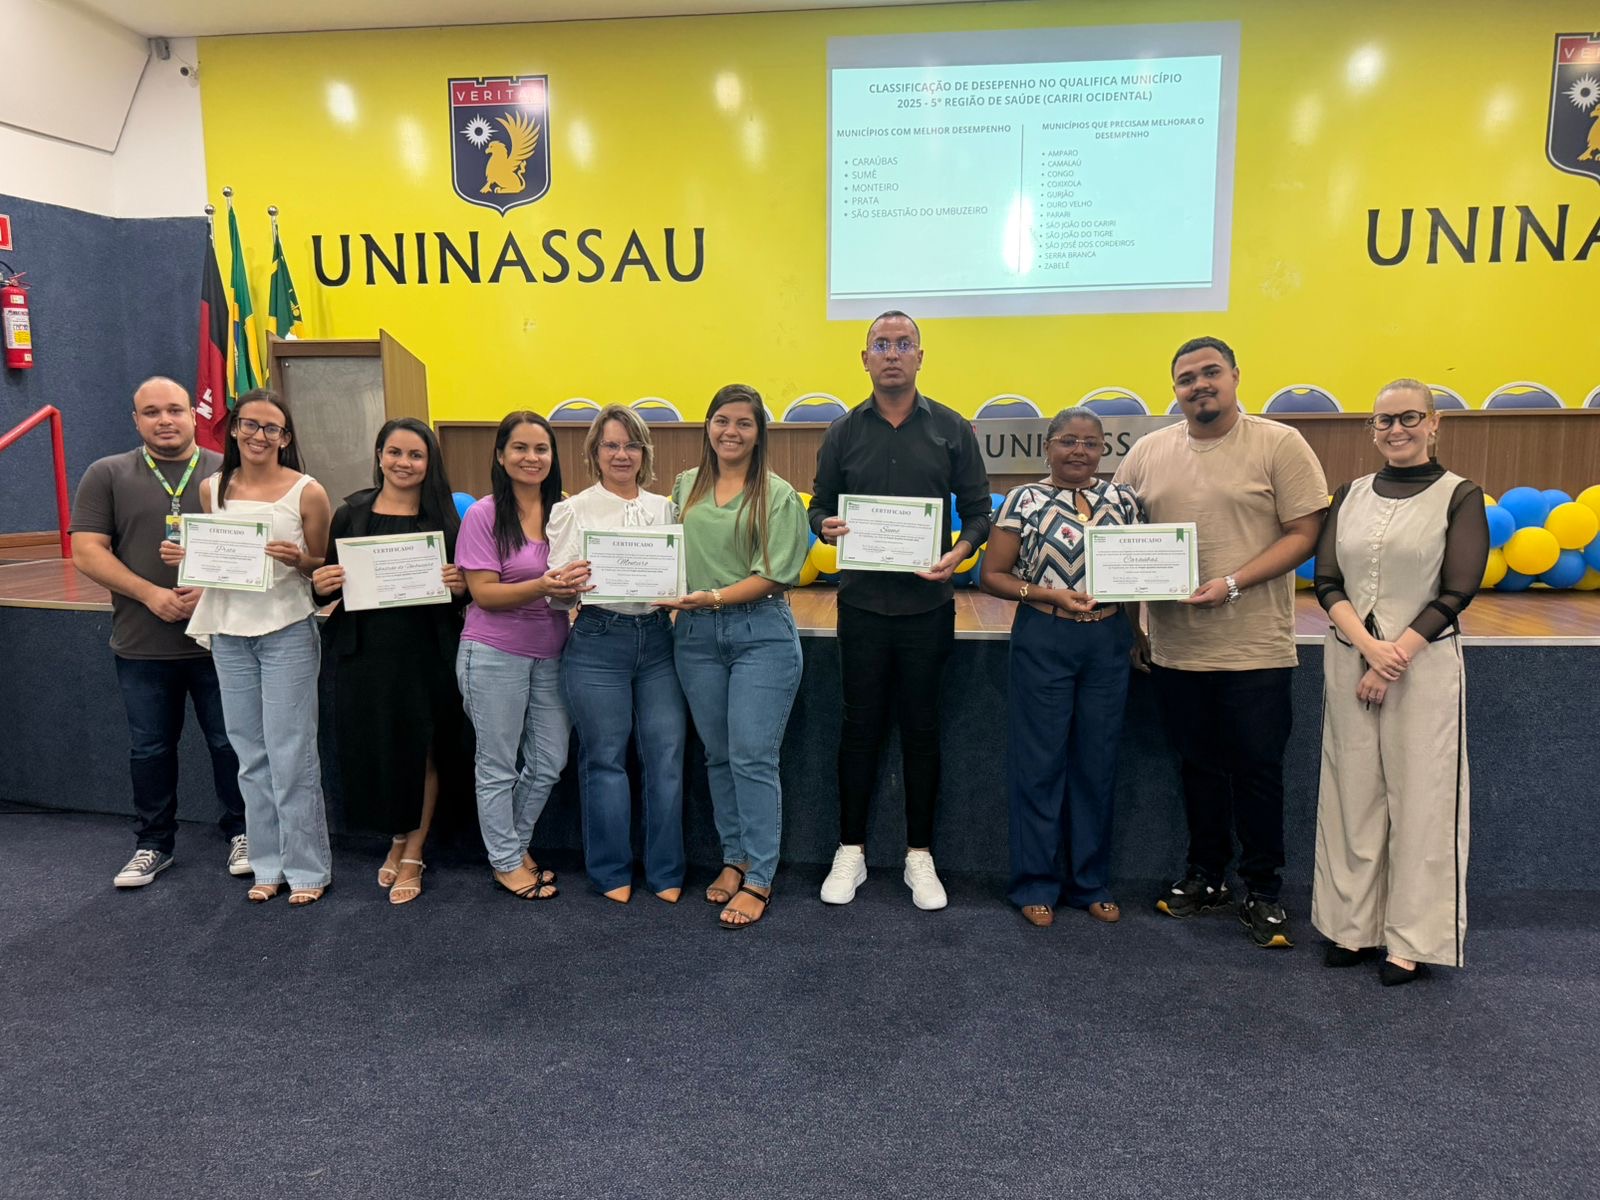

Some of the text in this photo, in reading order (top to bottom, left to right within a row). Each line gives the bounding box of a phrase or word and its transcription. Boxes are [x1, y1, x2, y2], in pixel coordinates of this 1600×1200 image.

[869, 72, 1182, 94] CLASSIFICAÇÃO DE DESEPENHO NO QUALIFICA MUNICÍPIO
[897, 99, 921, 108] 2025
[944, 94, 985, 107] REGIÃO
[988, 96, 1002, 105] DE
[1005, 93, 1040, 105] SAÚDE
[1043, 93, 1083, 105] (CARIRI
[1086, 90, 1152, 103] OCIDENTAL)
[1042, 117, 1205, 131] MUNICÍPIOS QUE PRECISAM MELHORAR O
[837, 124, 1011, 137] MUNICÍPIOS COM MELHOR DESEMPENHO
[1095, 130, 1149, 139] DESEMPENHO
[1048, 149, 1078, 157] AMPARO
[852, 157, 898, 166] CARAÚBAS
[1048, 159, 1081, 168] CAMALAÚ
[1047, 170, 1074, 178] CONGO
[852, 183, 899, 192] MONTEIRO
[852, 196, 879, 205] PRATA
[1069, 200, 1093, 208] VELHO
[851, 206, 988, 218] SÃO SEBASTIÃO DO UMBUZEIRO
[1046, 221, 1060, 229] SÃO
[1046, 231, 1060, 239] SÃO
[1045, 241, 1060, 249] SÃO
[1095, 239, 1135, 247] CORDEIROS
[311, 226, 706, 288] UNINASSAU
[209, 528, 245, 536] CERTIFICADO
